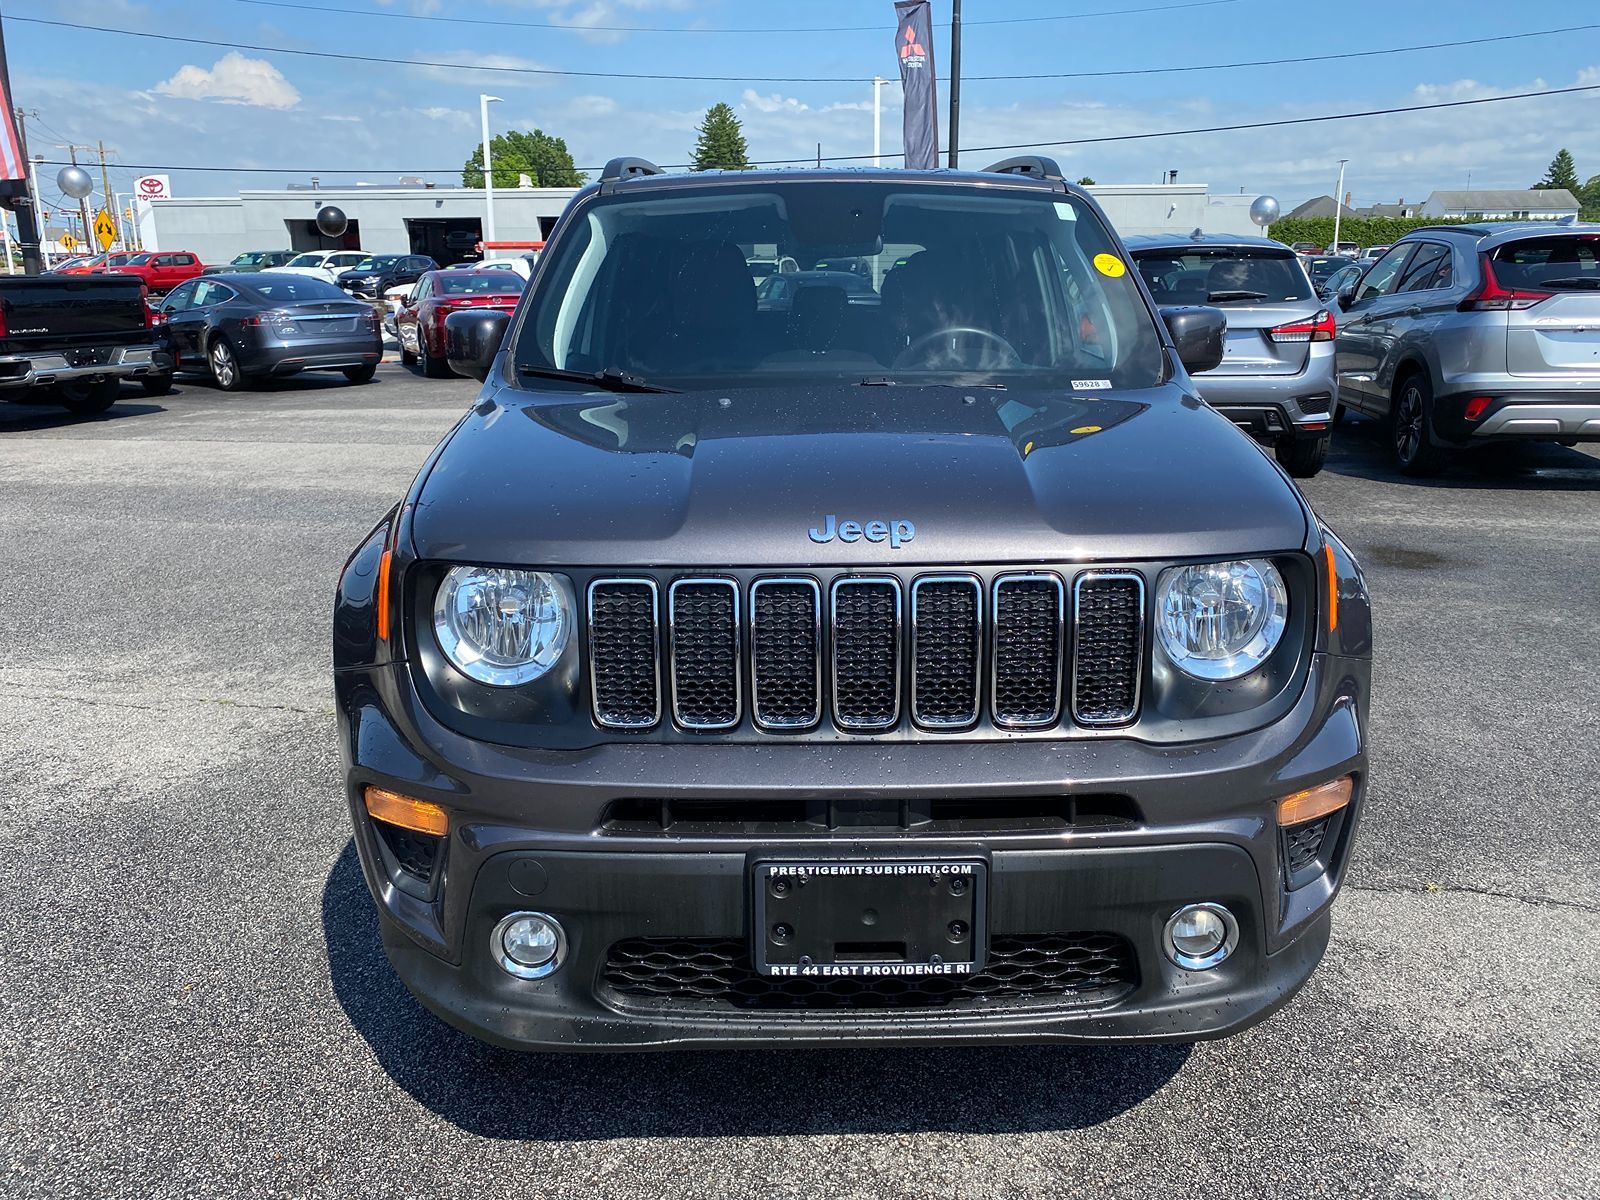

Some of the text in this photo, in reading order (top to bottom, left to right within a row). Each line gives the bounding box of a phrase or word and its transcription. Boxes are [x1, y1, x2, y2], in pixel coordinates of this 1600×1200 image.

[808, 514, 916, 550] Jeep
[770, 865, 972, 876] PRESTIGEMITSUBISHIRI.COM
[771, 964, 970, 976] RTE 44 EAST PROVIDENCE RI
